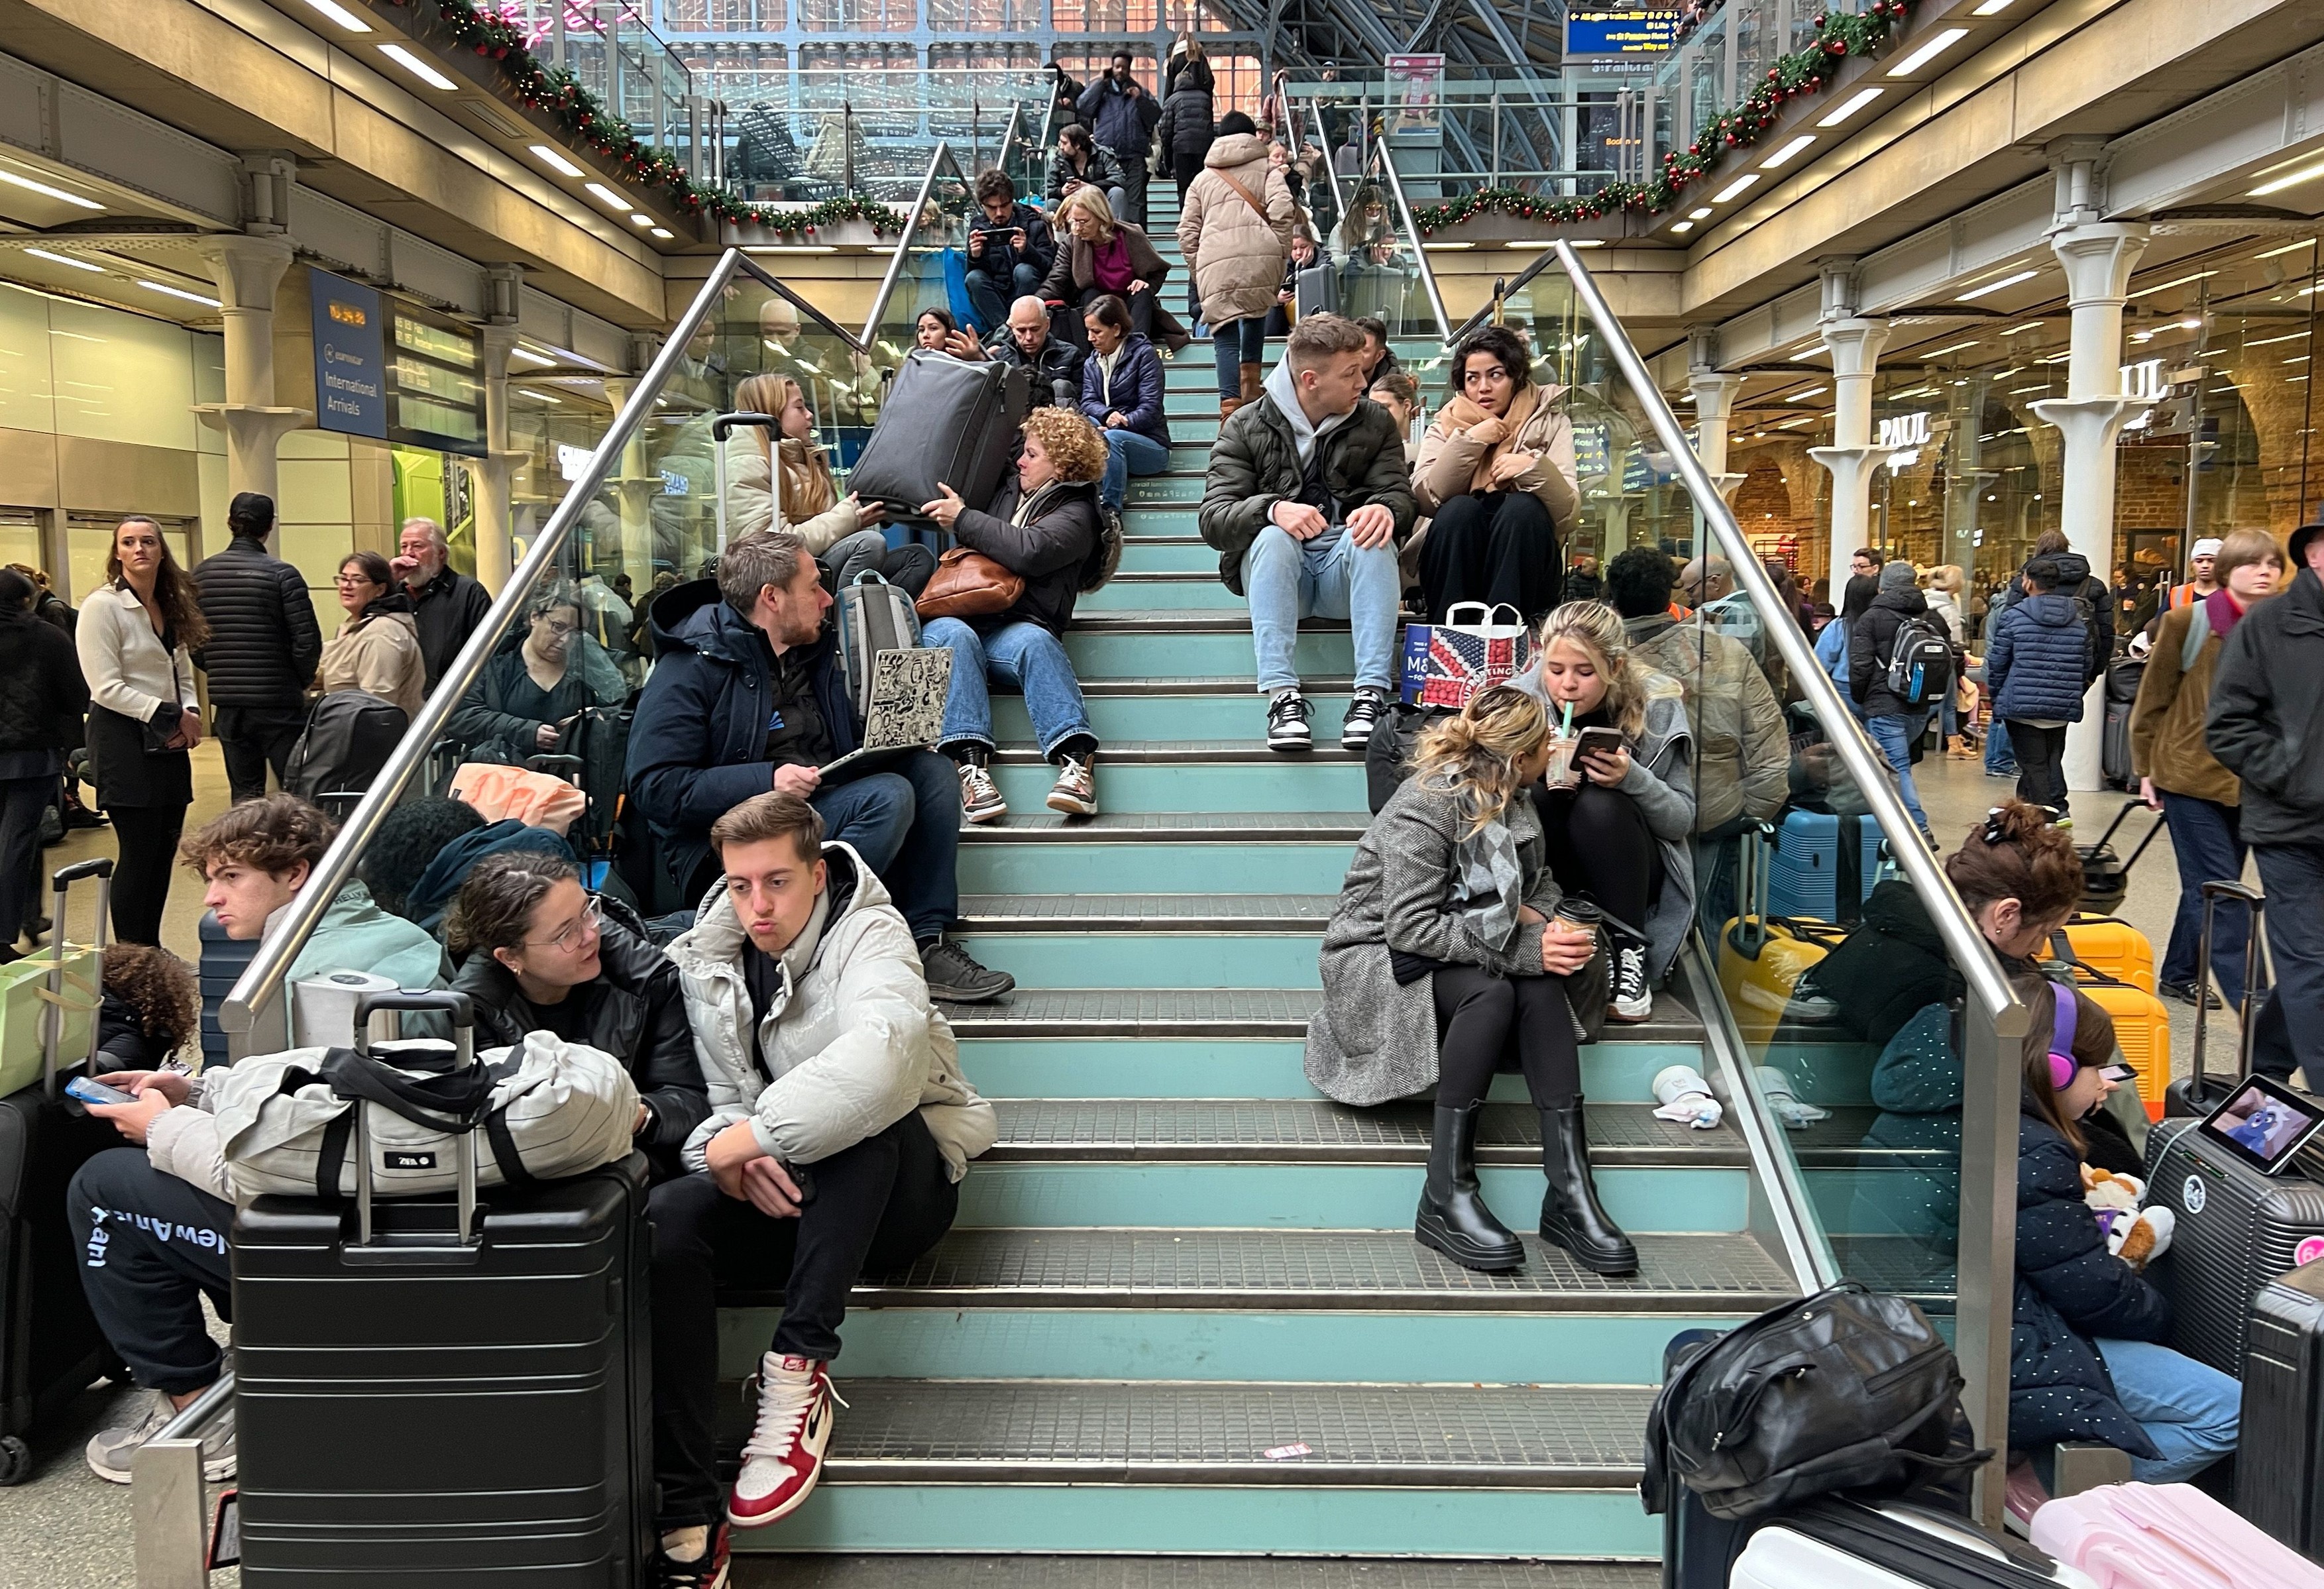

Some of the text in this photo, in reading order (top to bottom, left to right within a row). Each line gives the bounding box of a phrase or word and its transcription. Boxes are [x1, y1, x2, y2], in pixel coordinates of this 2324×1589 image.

[325, 371, 378, 398] International
[2118, 358, 2167, 400] UL
[327, 394, 360, 416] Arrivals
[1879, 411, 1931, 448] PAUL
[334, 890, 363, 905] HELLY
